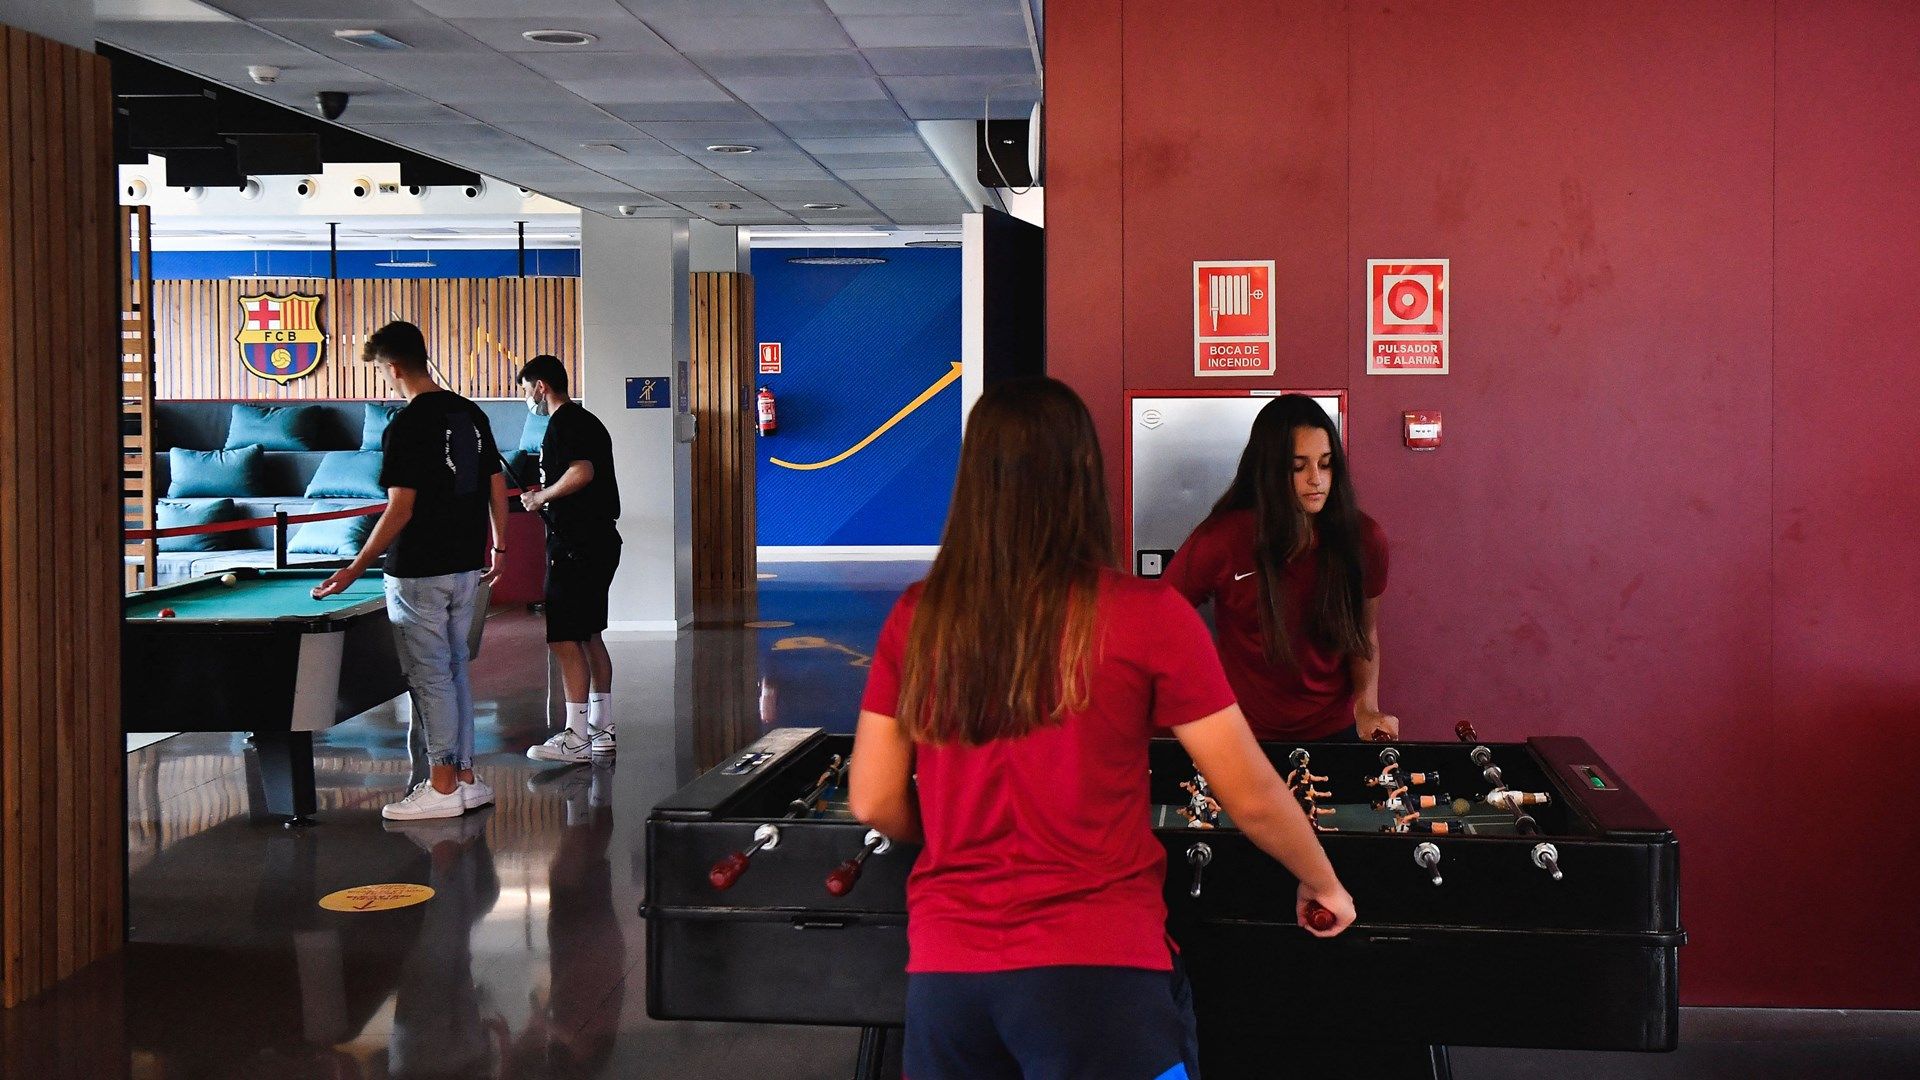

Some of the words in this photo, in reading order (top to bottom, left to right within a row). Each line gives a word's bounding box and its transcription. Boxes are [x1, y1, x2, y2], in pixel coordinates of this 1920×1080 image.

[265, 331, 296, 341] FCB
[1210, 346, 1242, 355] BOCA
[1244, 346, 1259, 355] DE
[1378, 344, 1438, 353] PULSADOR
[1208, 358, 1261, 367] INCENDIO
[1376, 356, 1390, 365] DE
[1394, 356, 1440, 365] ALARMA
